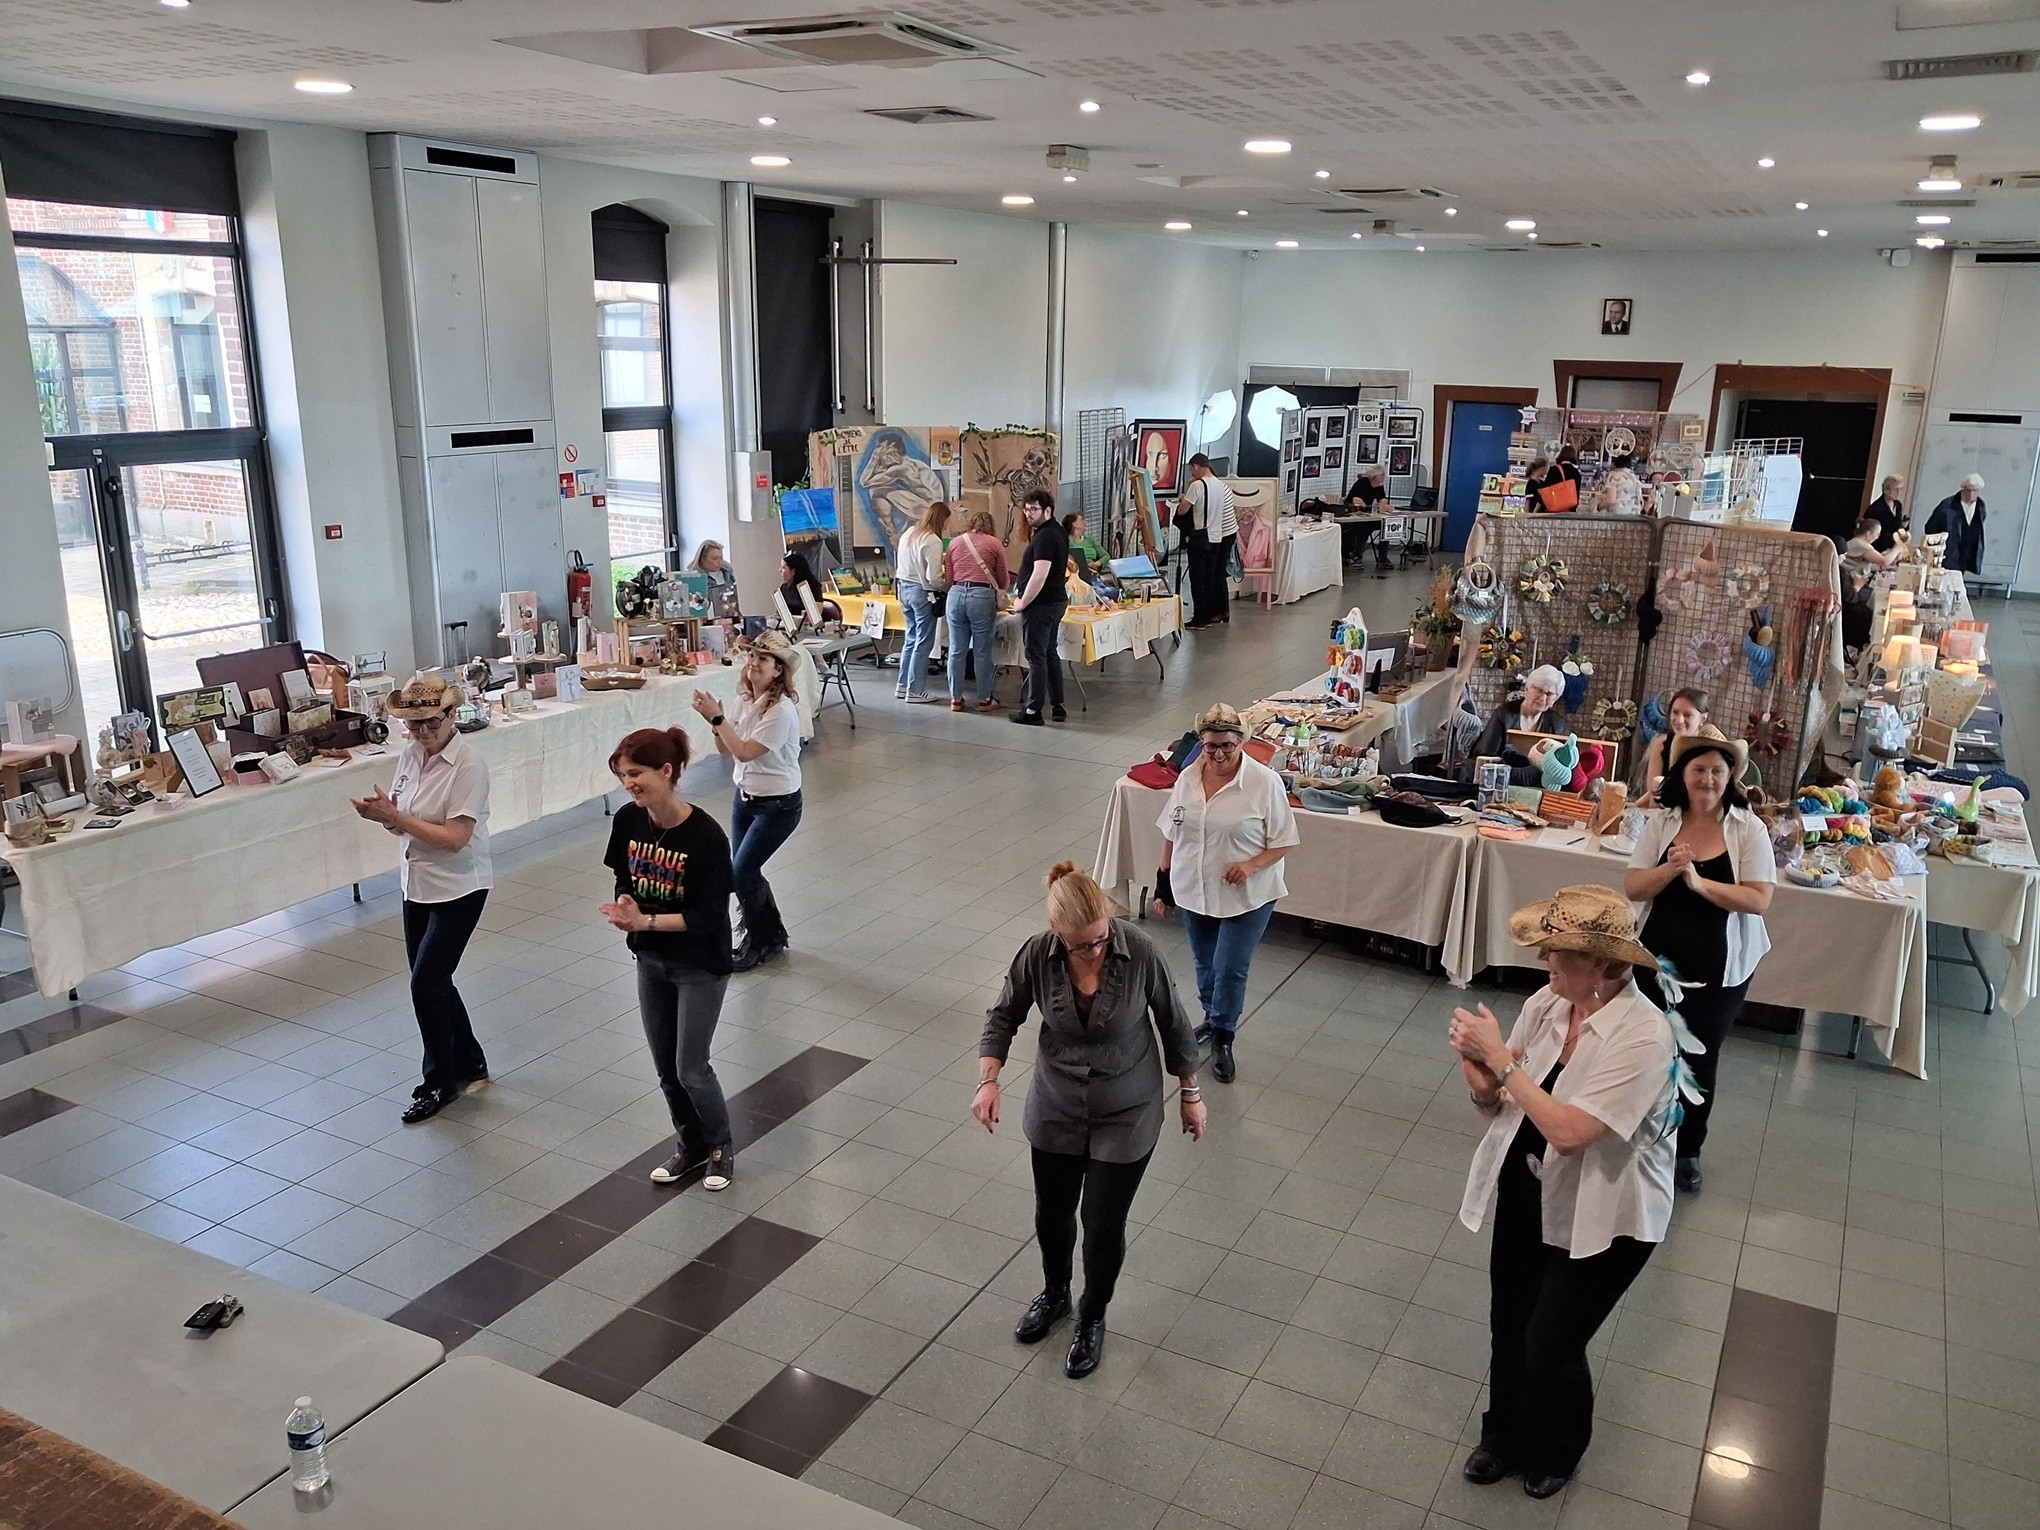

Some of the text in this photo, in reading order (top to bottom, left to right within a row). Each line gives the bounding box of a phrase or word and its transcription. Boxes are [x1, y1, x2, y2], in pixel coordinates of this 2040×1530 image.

[1361, 414, 1379, 422] TOP
[1387, 524, 1401, 532] TOP
[628, 840, 688, 874] PULQUE
